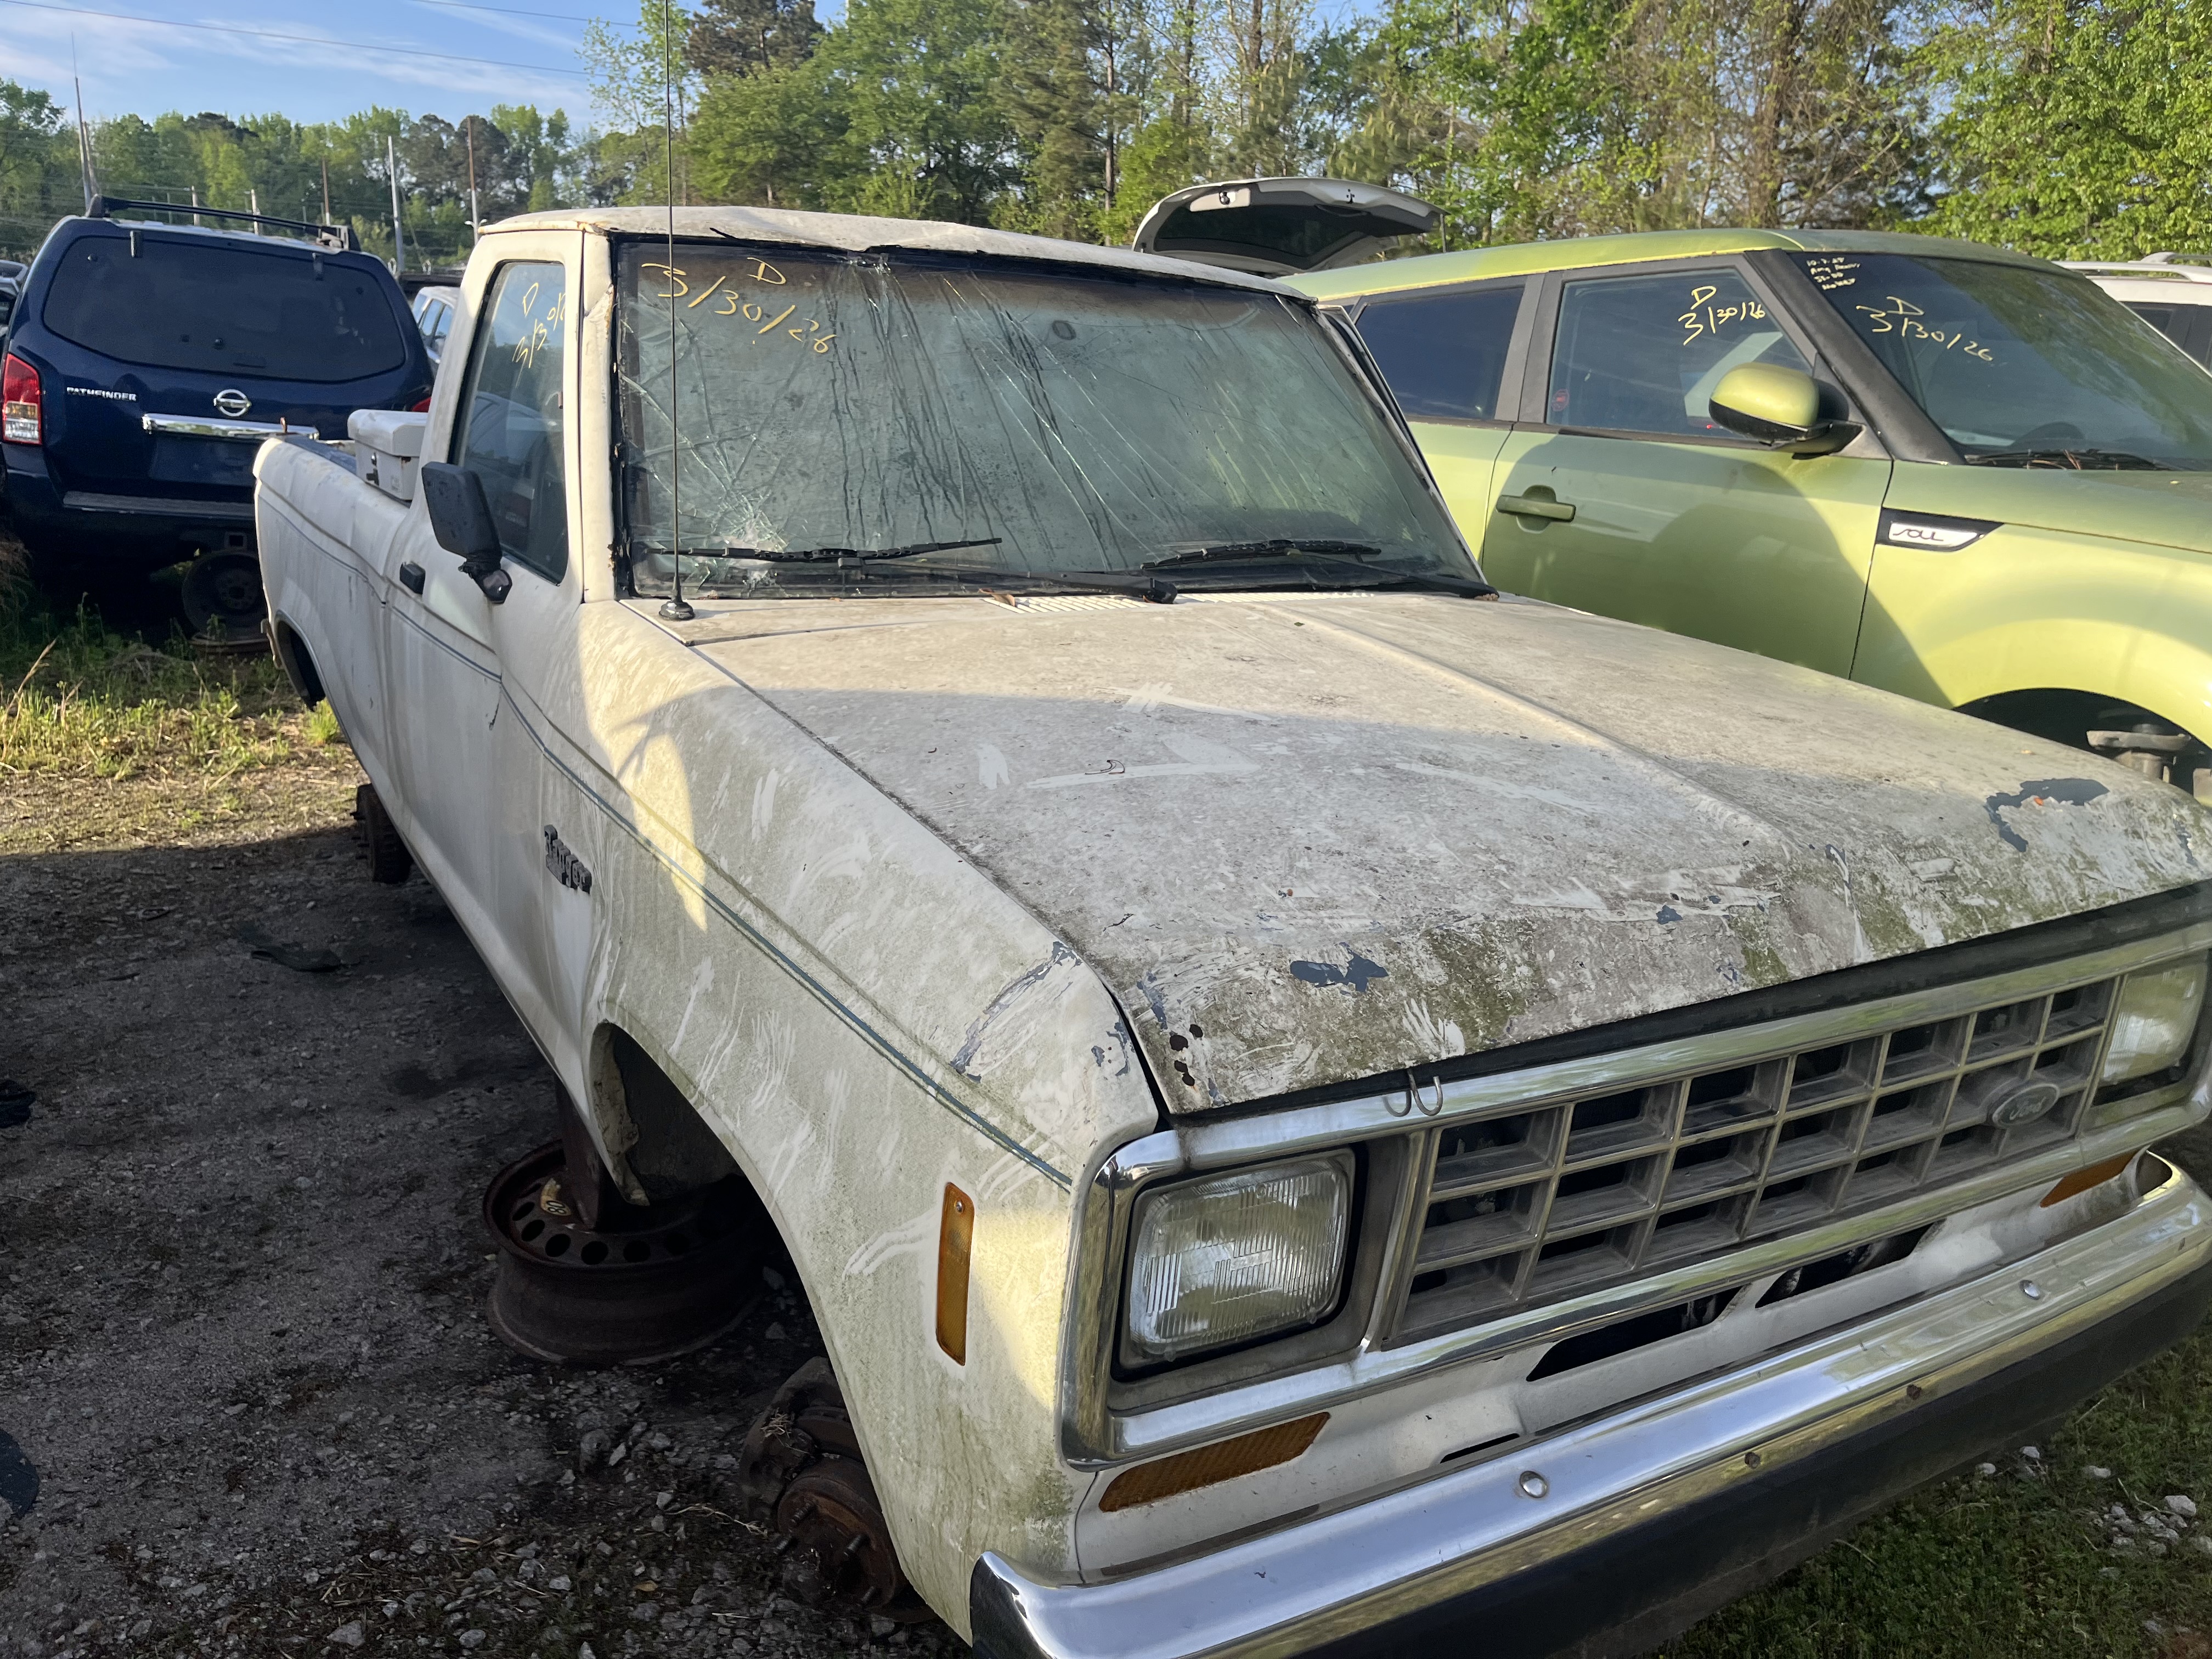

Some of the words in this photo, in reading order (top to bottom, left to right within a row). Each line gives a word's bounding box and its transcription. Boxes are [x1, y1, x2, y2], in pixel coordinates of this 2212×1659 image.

[747, 257, 786, 284] D
[523, 282, 539, 318] D
[641, 263, 837, 353] 3/30/26
[1690, 285, 1717, 310] D
[1886, 296, 1925, 315] D
[1678, 302, 1766, 346] 3/30/26
[1856, 305, 1993, 362] 3/30/26
[66, 387, 137, 402] PATHFINDER
